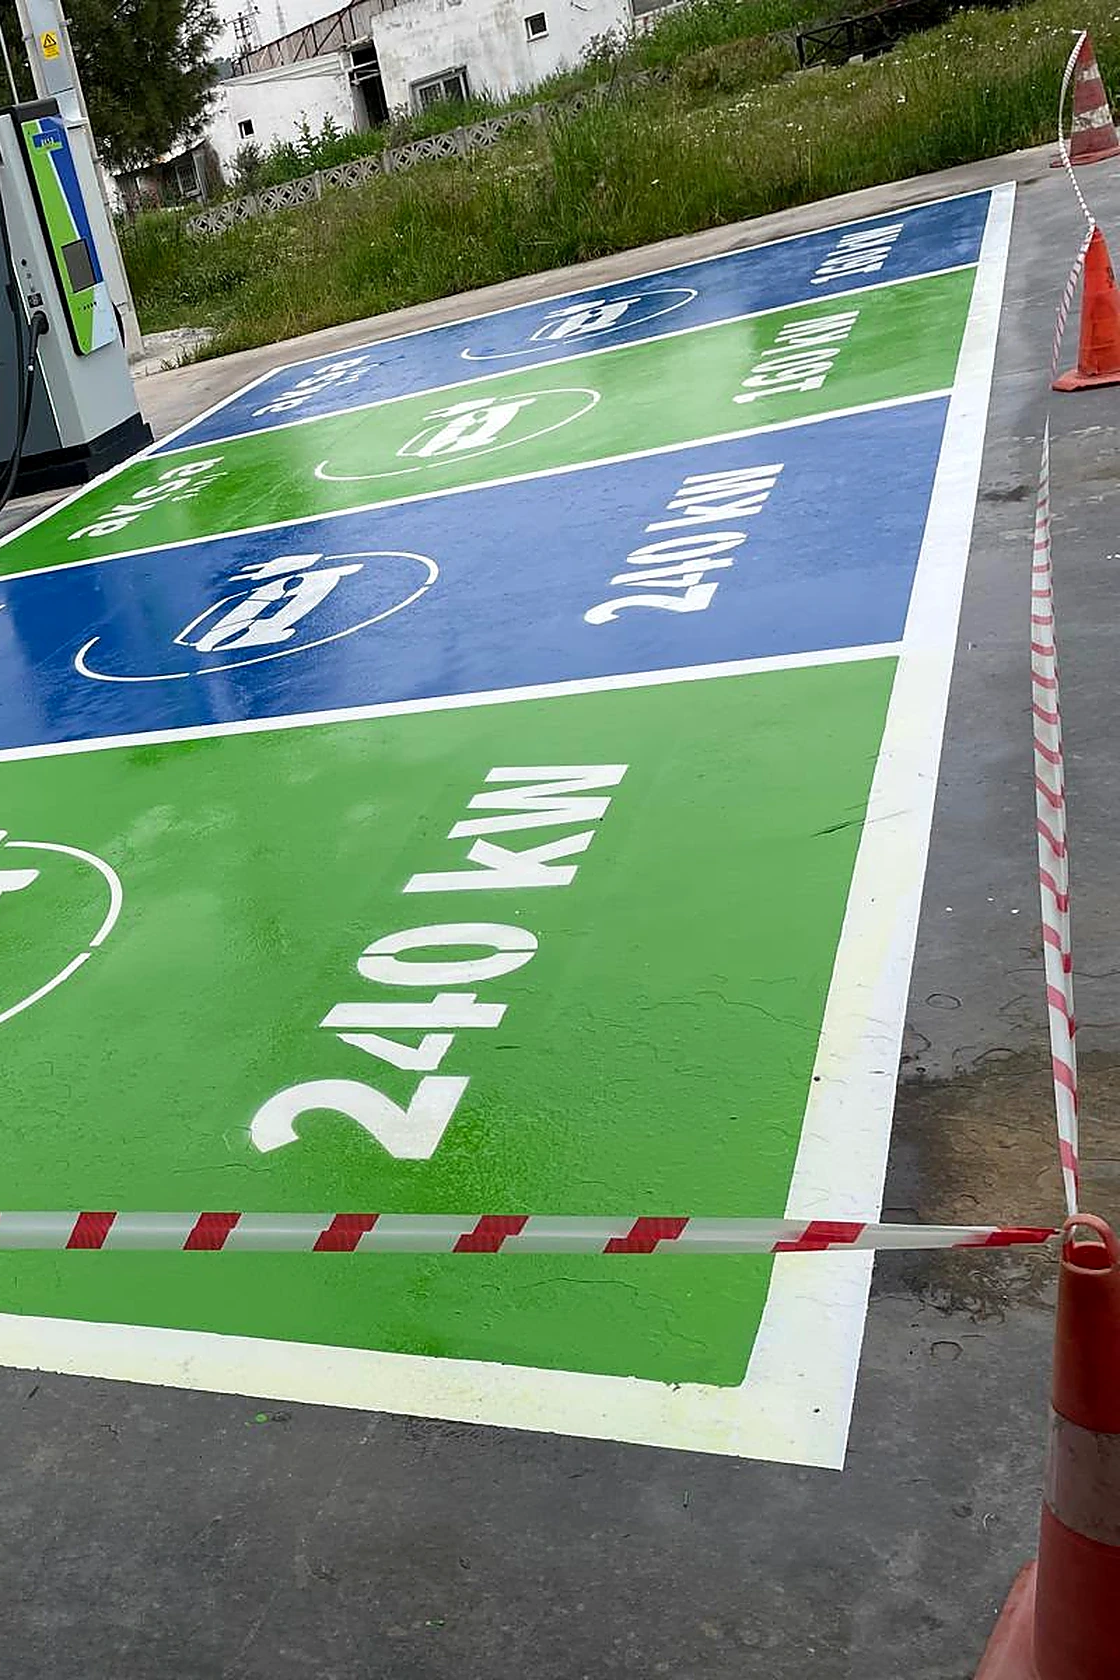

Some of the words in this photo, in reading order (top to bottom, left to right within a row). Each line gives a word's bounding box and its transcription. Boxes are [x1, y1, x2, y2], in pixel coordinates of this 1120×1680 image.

[732, 348, 841, 404] 150
[583, 530, 748, 625] 240
[250, 922, 539, 1160] 240
